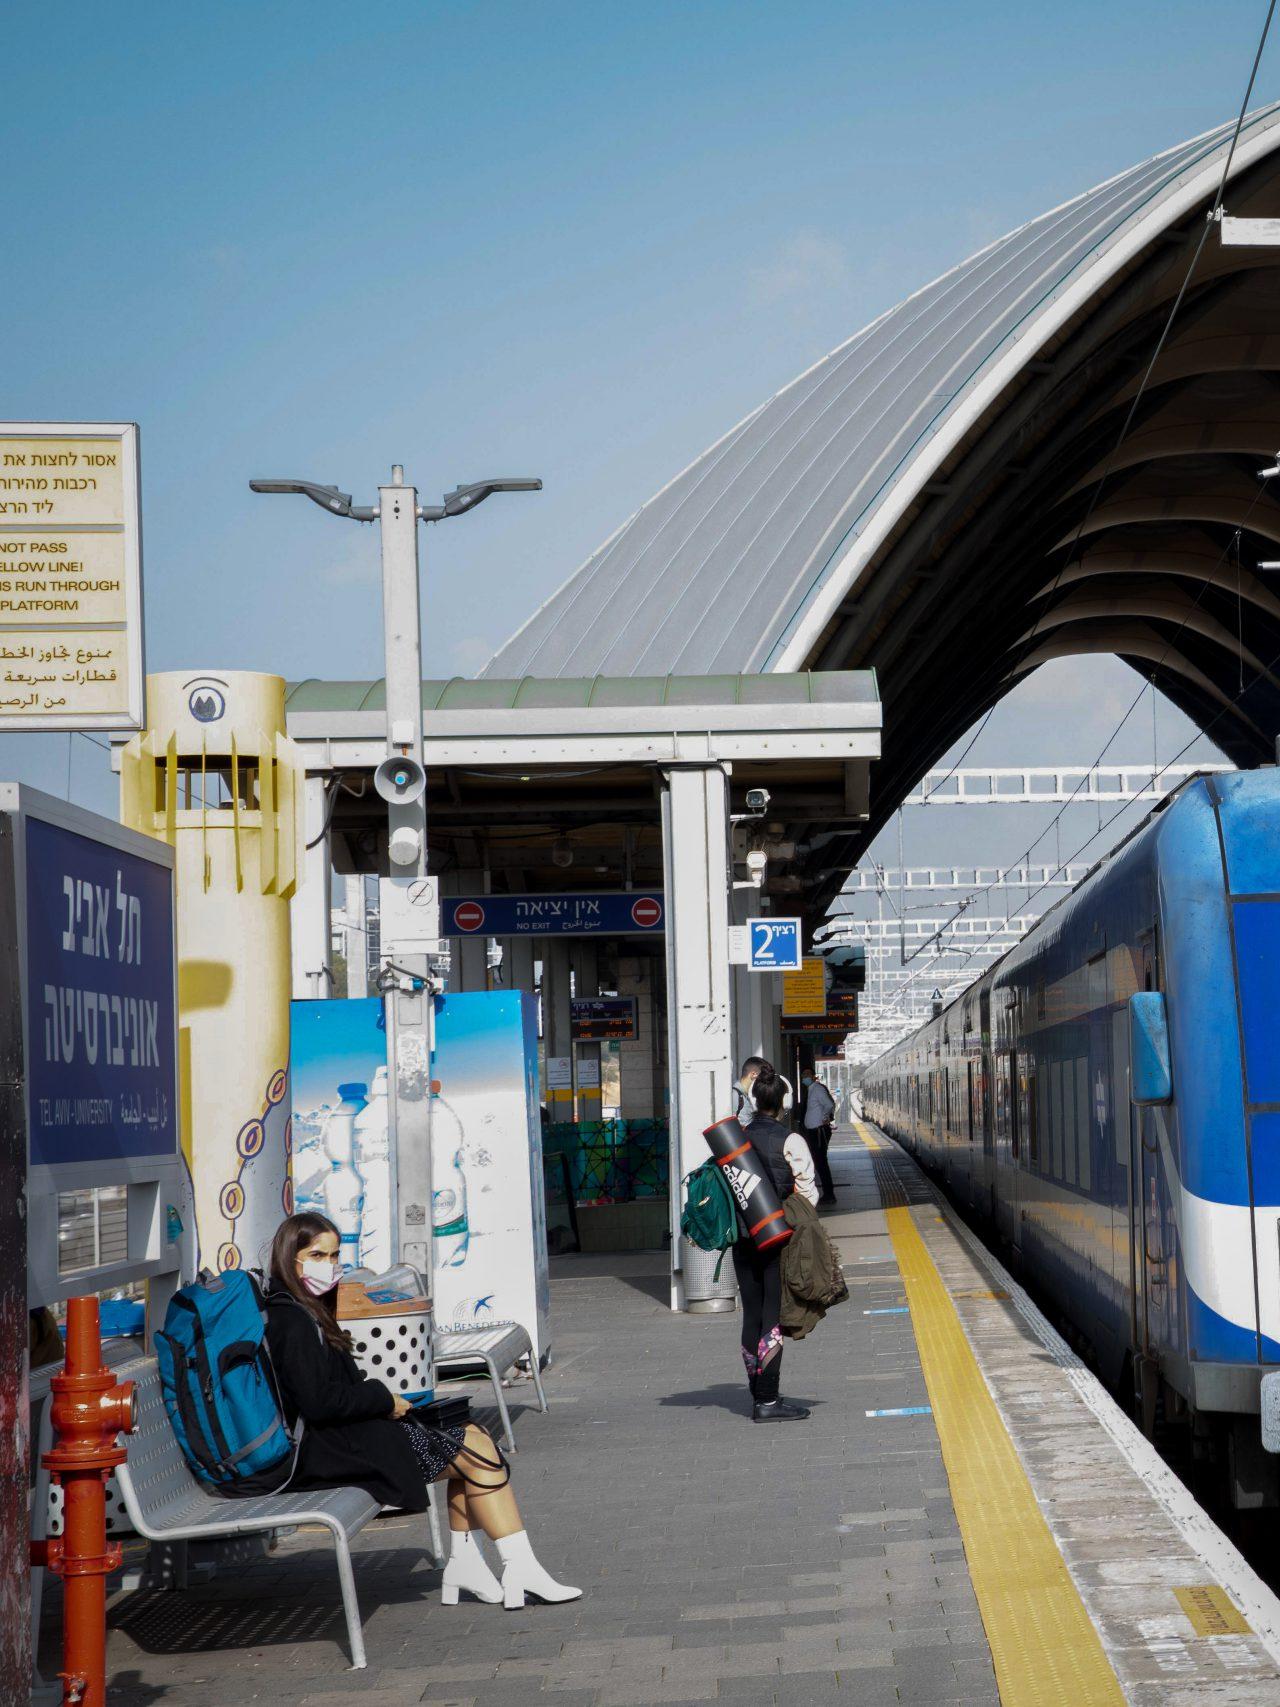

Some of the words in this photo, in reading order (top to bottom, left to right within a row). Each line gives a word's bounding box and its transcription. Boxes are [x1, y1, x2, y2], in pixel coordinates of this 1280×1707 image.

[3, 454, 26, 466] את
[31, 451, 78, 466] לחצות
[82, 454, 116, 466] אסור
[53, 478, 97, 490] רכבות
[32, 500, 54, 513] ליד
[30, 542, 68, 553] PASS
[48, 562, 84, 572] LINE!
[0, 581, 11, 592] S
[15, 581, 46, 591] RUN
[49, 580, 120, 591] THROUGH
[0, 600, 79, 611] PLATFORM
[38, 645, 71, 663] تجاوز
[76, 647, 112, 664] ممنوع
[4, 670, 57, 685] سريعة
[62, 670, 117, 685] قطارات
[44, 696, 66, 709] من
[516, 900, 568, 916] יציאה
[575, 900, 600, 919] אין
[62, 875, 110, 960] אביב
[116, 869, 141, 965] תל
[516, 922, 529, 930] NO
[531, 922, 551, 930] EXIT
[772, 925, 795, 937] רציף
[754, 924, 774, 959] 2
[44, 983, 160, 1068] אוניברסיטה
[39, 1098, 53, 1127] TEL
[722, 1163, 749, 1211] adidas
